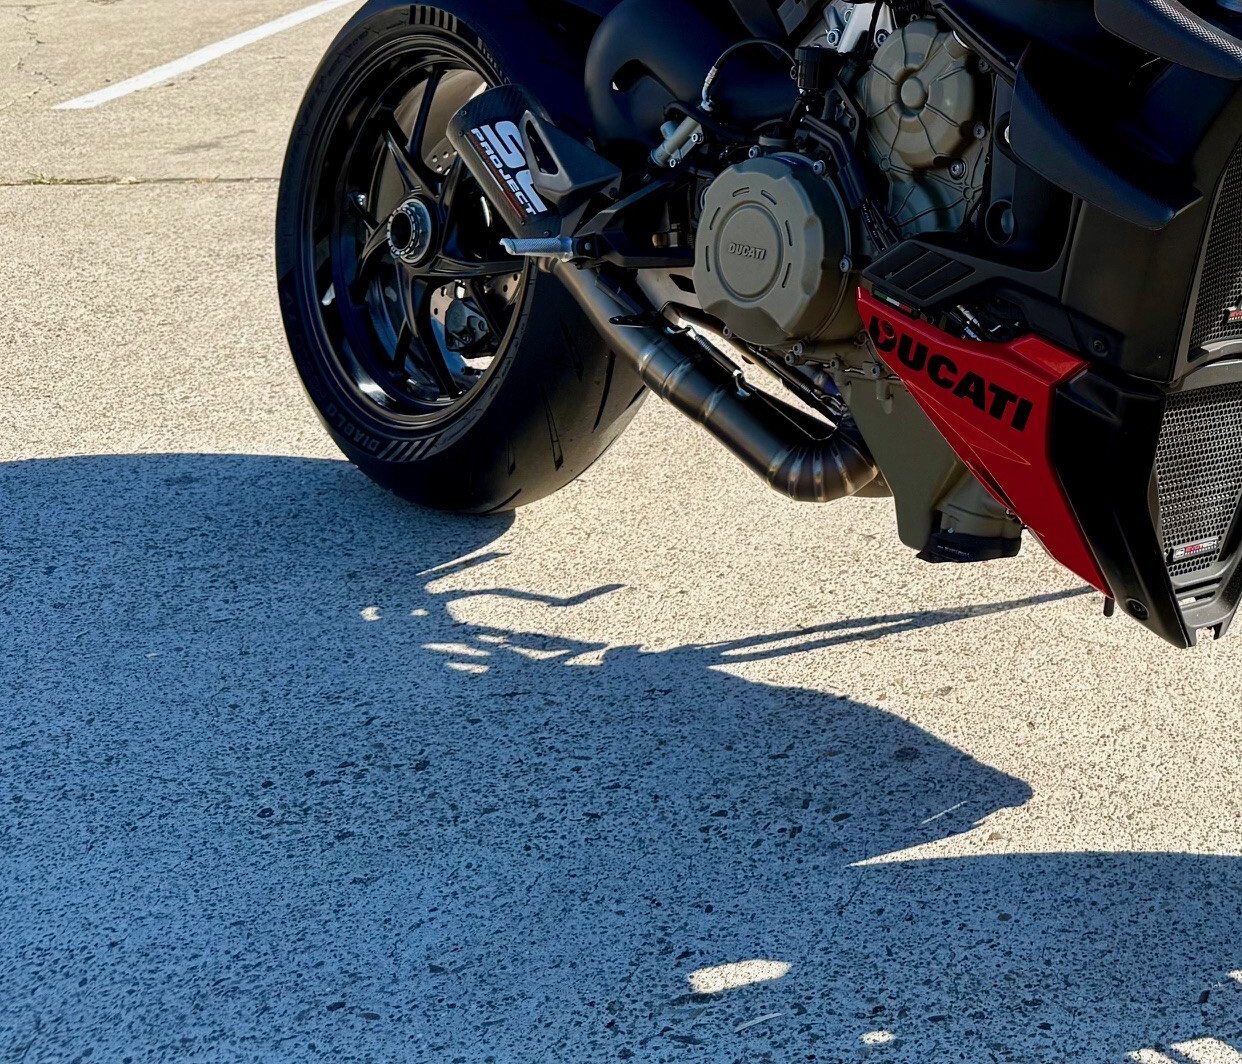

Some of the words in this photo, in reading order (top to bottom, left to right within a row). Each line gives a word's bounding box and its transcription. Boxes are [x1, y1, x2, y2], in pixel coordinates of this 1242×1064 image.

[470, 127, 537, 215] PROJECT
[728, 242, 767, 260] DUCATI
[868, 315, 1034, 432] DUCATI
[326, 402, 382, 454] DIABLO
